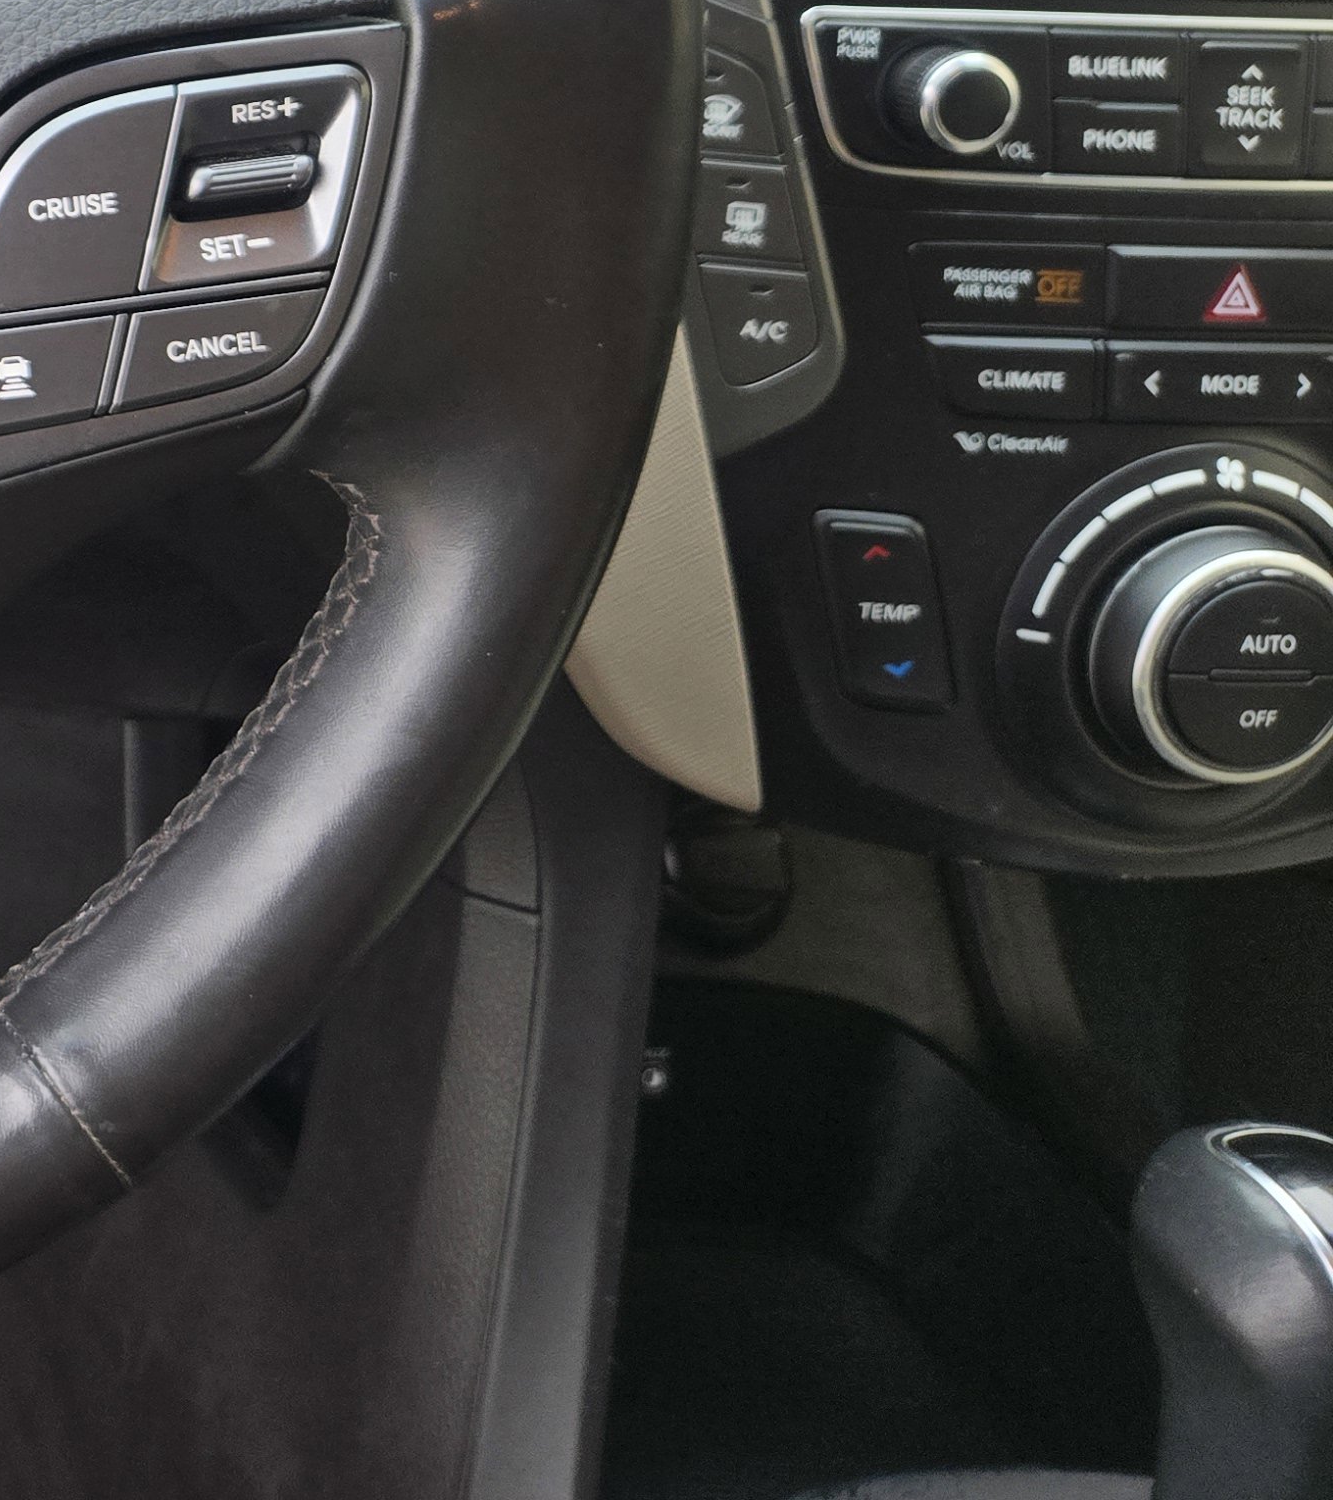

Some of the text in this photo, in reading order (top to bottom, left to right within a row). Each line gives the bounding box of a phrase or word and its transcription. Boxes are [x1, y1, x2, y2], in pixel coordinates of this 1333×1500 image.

[837, 26, 881, 45] PWR
[836, 45, 880, 60] PUSH
[1067, 56, 1168, 80] BLUELINK
[1226, 85, 1275, 108] SEEK
[232, 97, 303, 124] RES+
[1216, 107, 1283, 132] TRACK
[995, 140, 1035, 161] VOL
[1082, 129, 1158, 152] PHONE
[27, 192, 121, 223] CRUISE
[721, 229, 764, 248] REAR
[943, 266, 1082, 298] PASSENGER OFF
[953, 283, 1019, 300] AIR BAG
[739, 318, 790, 343] A/C
[166, 330, 269, 364] CANCEL
[978, 368, 1066, 392] CLIMATE
[1201, 373, 1260, 396] MODE
[987, 432, 1070, 454] CleanAir
[858, 601, 921, 623] TEMP
[1240, 633, 1297, 655] AUTO
[1239, 708, 1278, 729] OFF
